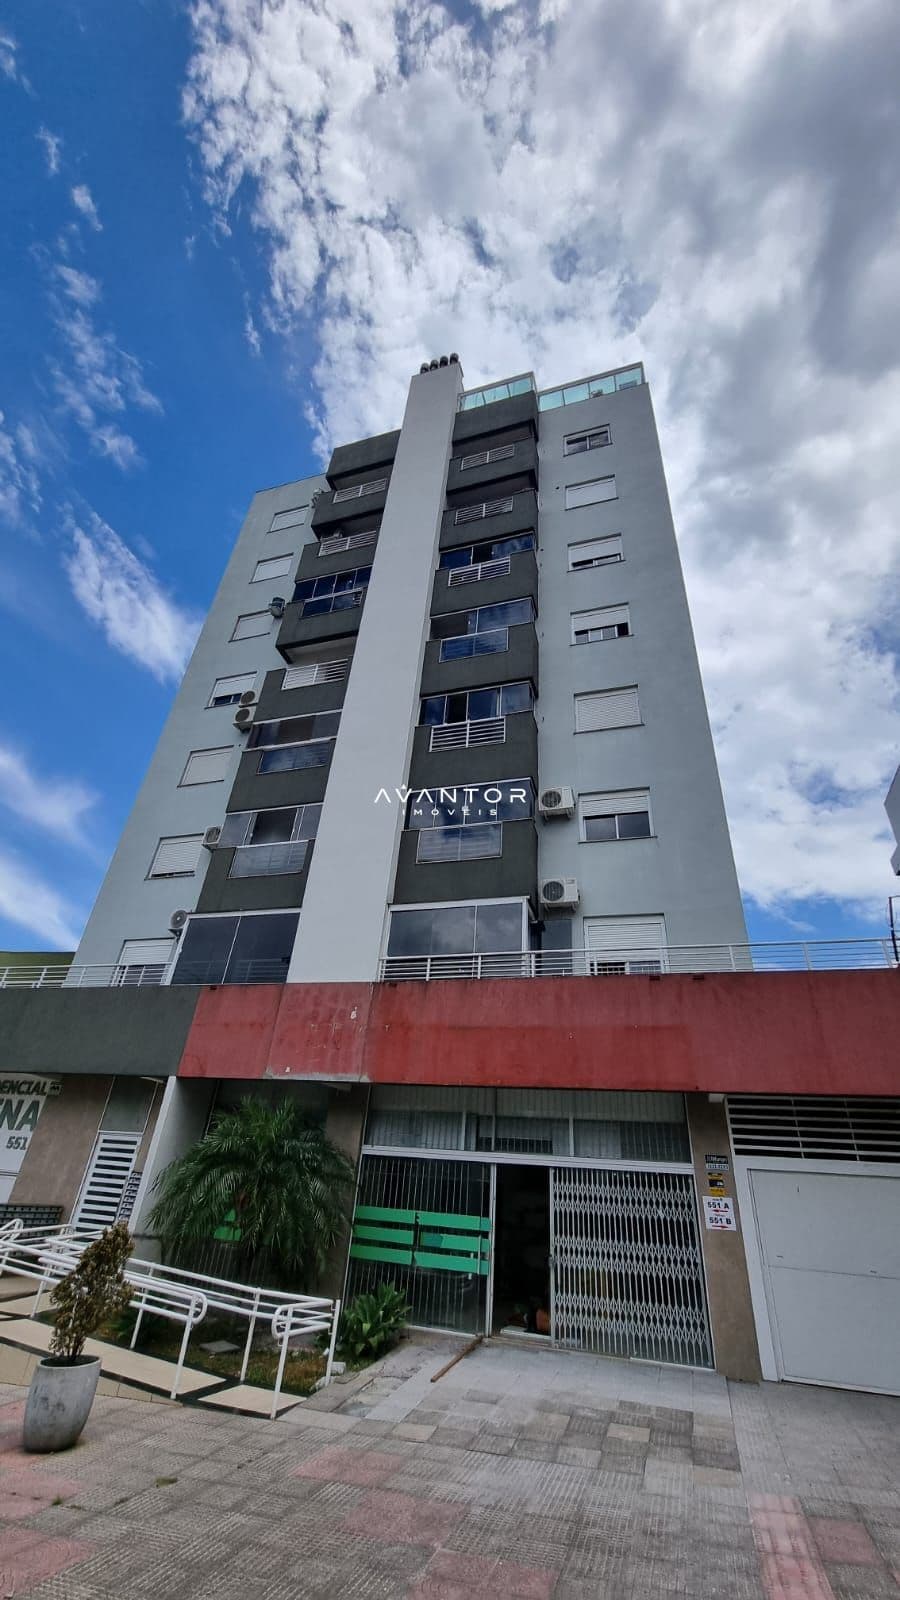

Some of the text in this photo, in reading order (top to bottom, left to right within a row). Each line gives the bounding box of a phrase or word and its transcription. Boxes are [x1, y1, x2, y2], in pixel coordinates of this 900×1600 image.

[0, 1080, 48, 1096] ENCIAL
[0, 1099, 40, 1132] NA
[6, 1136, 28, 1150] 551
[707, 1201, 721, 1209] 551
[709, 1216, 723, 1224] 551
